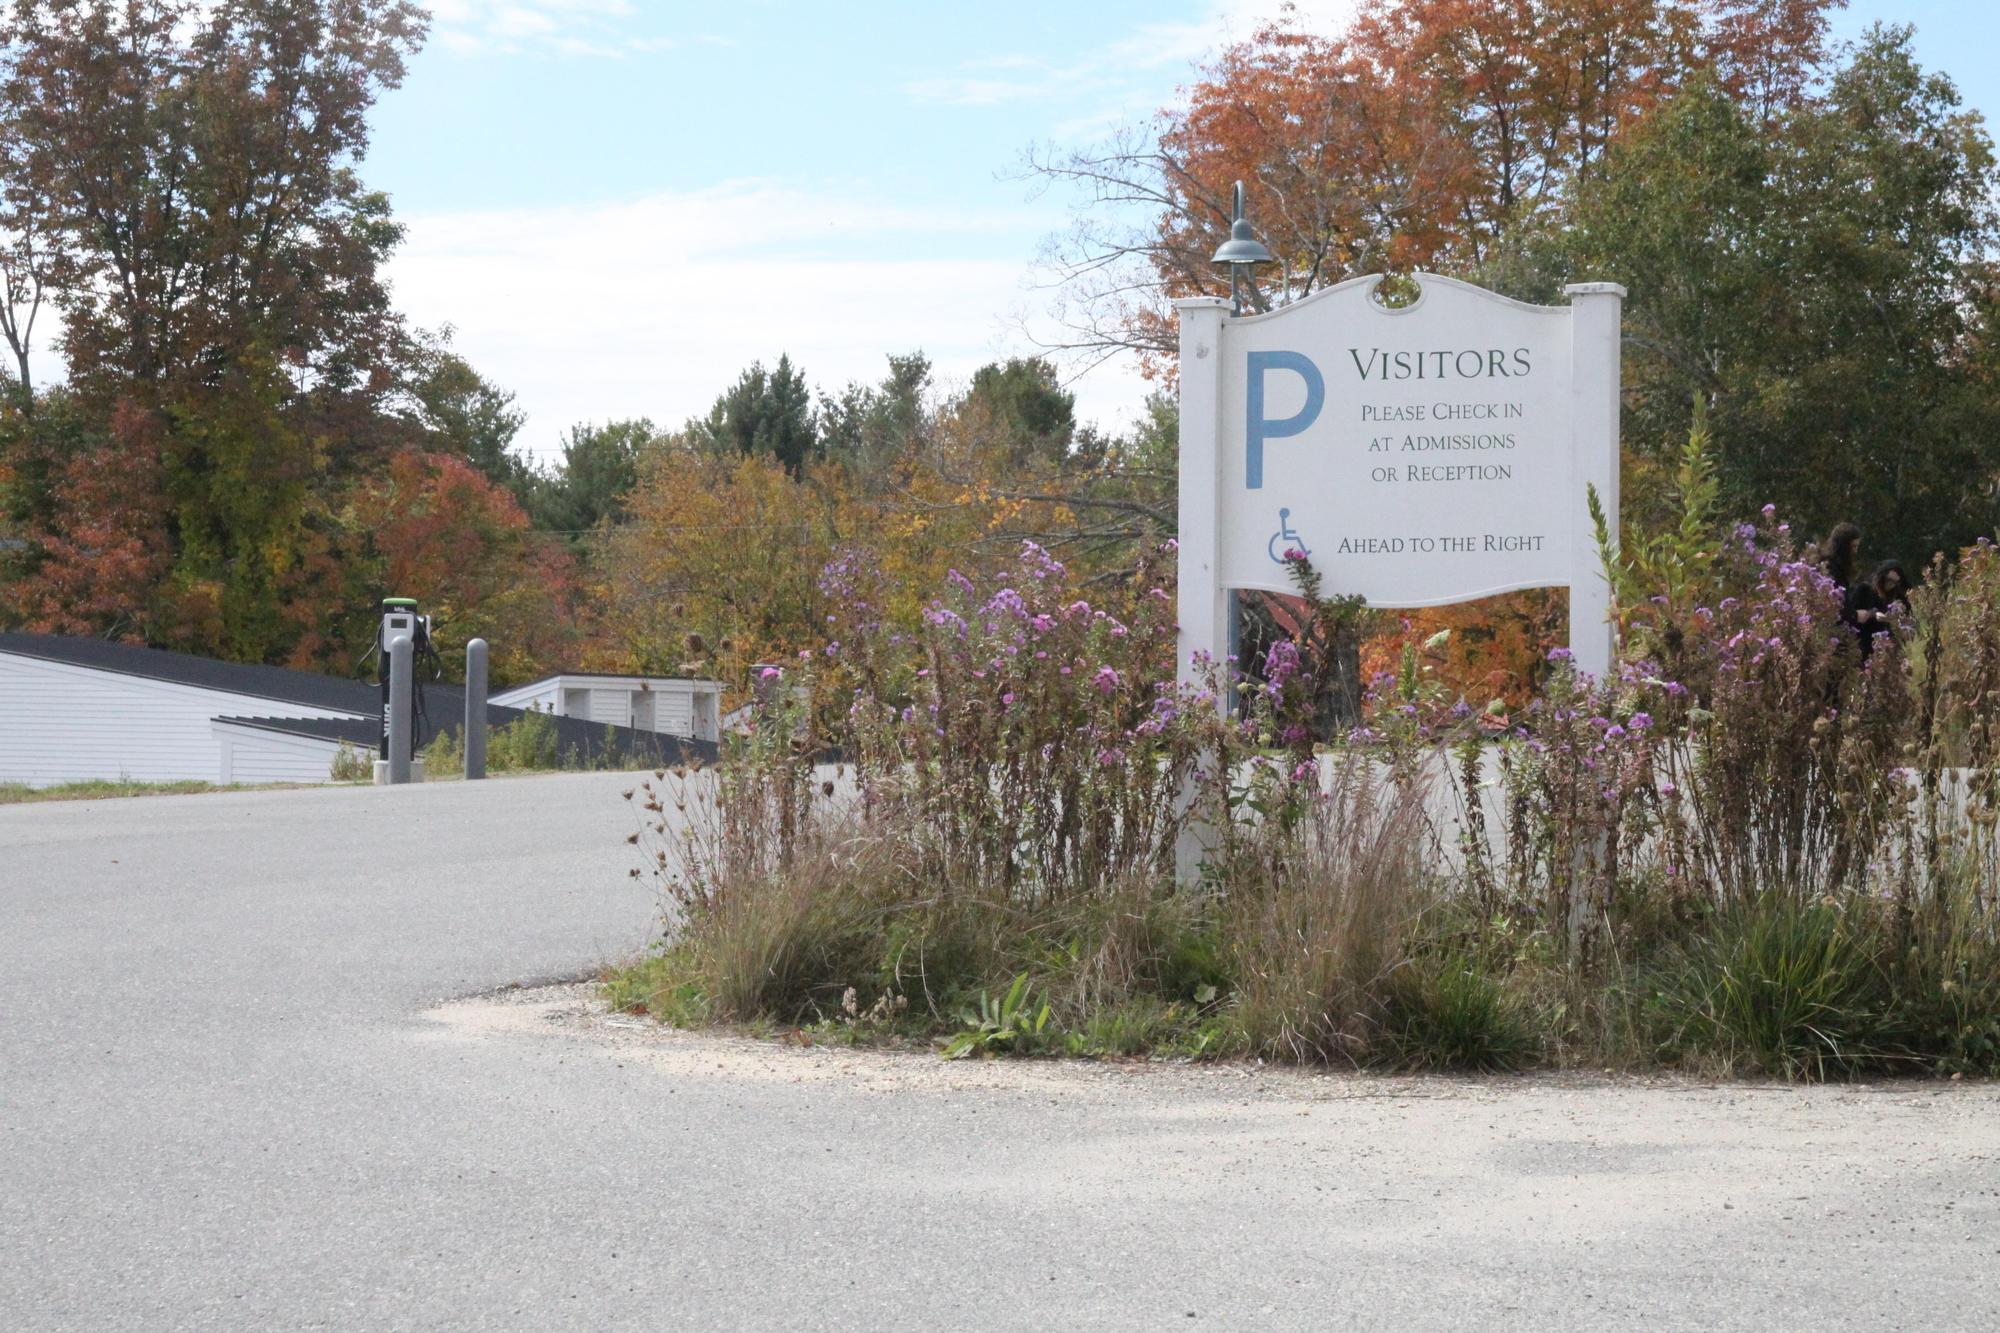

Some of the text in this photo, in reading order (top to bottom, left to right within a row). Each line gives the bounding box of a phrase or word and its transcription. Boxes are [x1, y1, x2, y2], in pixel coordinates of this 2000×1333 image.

[1348, 348, 1531, 381] VISITORS
[1246, 350, 1325, 489] P
[1361, 403, 1523, 421] PLEASE CHECK IN
[1368, 435, 1516, 452] AT ADMISSIONS
[1371, 465, 1511, 482] OR RECEPTION
[1337, 534, 1545, 553] AHEAD TO THE RIGHT
